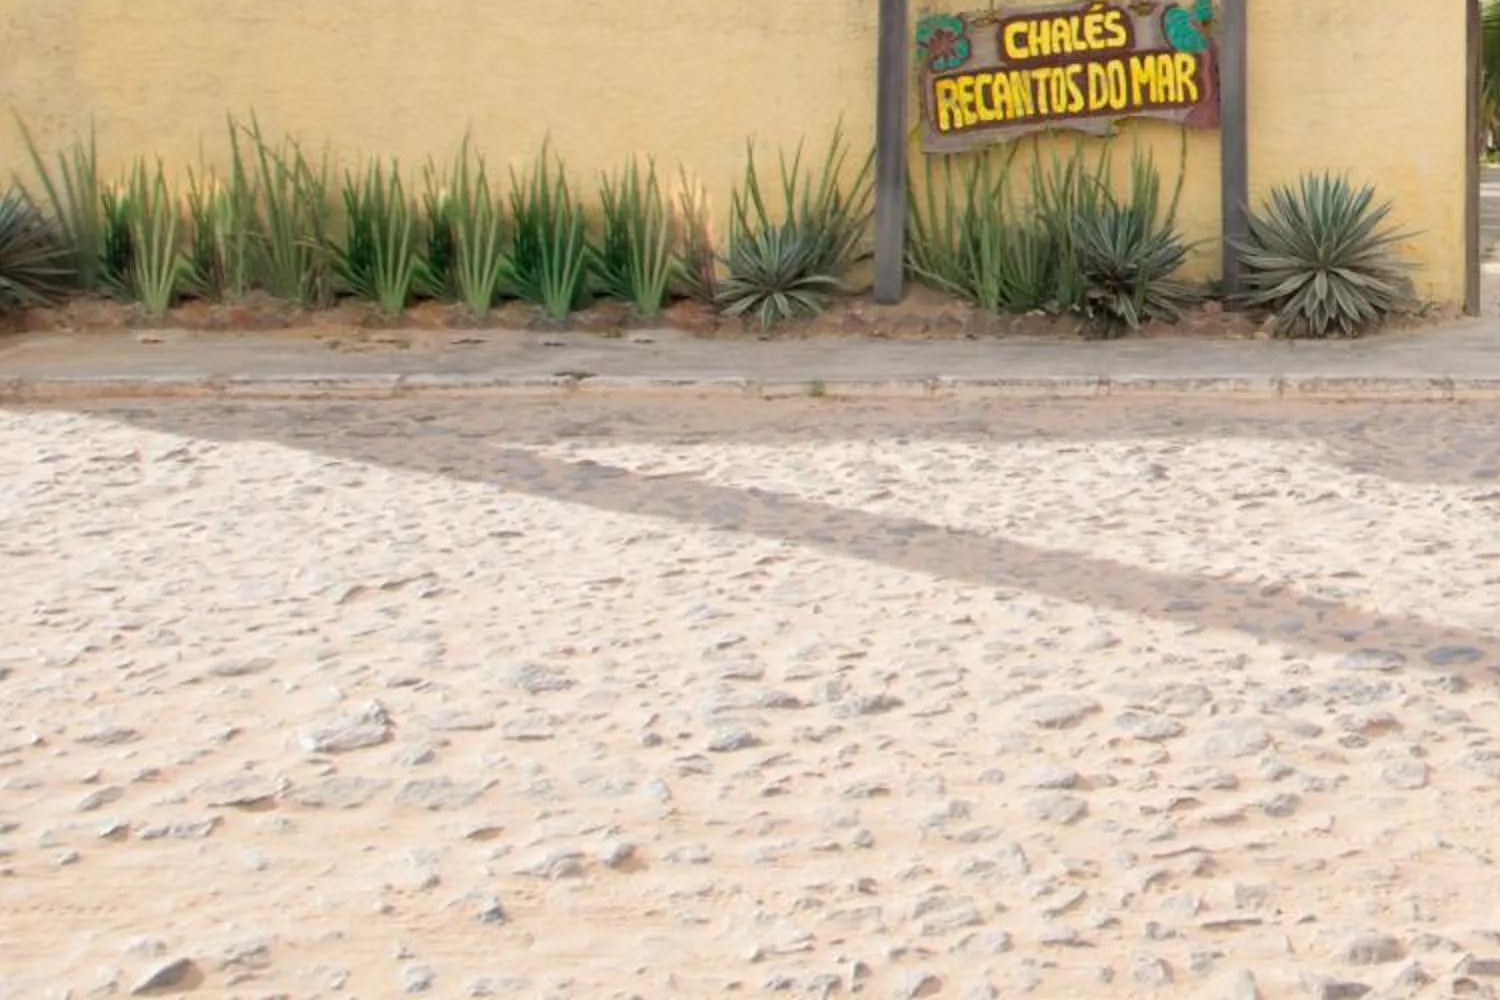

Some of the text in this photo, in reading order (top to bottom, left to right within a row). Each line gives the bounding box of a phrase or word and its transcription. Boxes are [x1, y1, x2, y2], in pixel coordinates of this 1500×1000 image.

[1003, 2, 1127, 60] CHALÉS
[934, 53, 1199, 132] RECANTOS DO MAR
